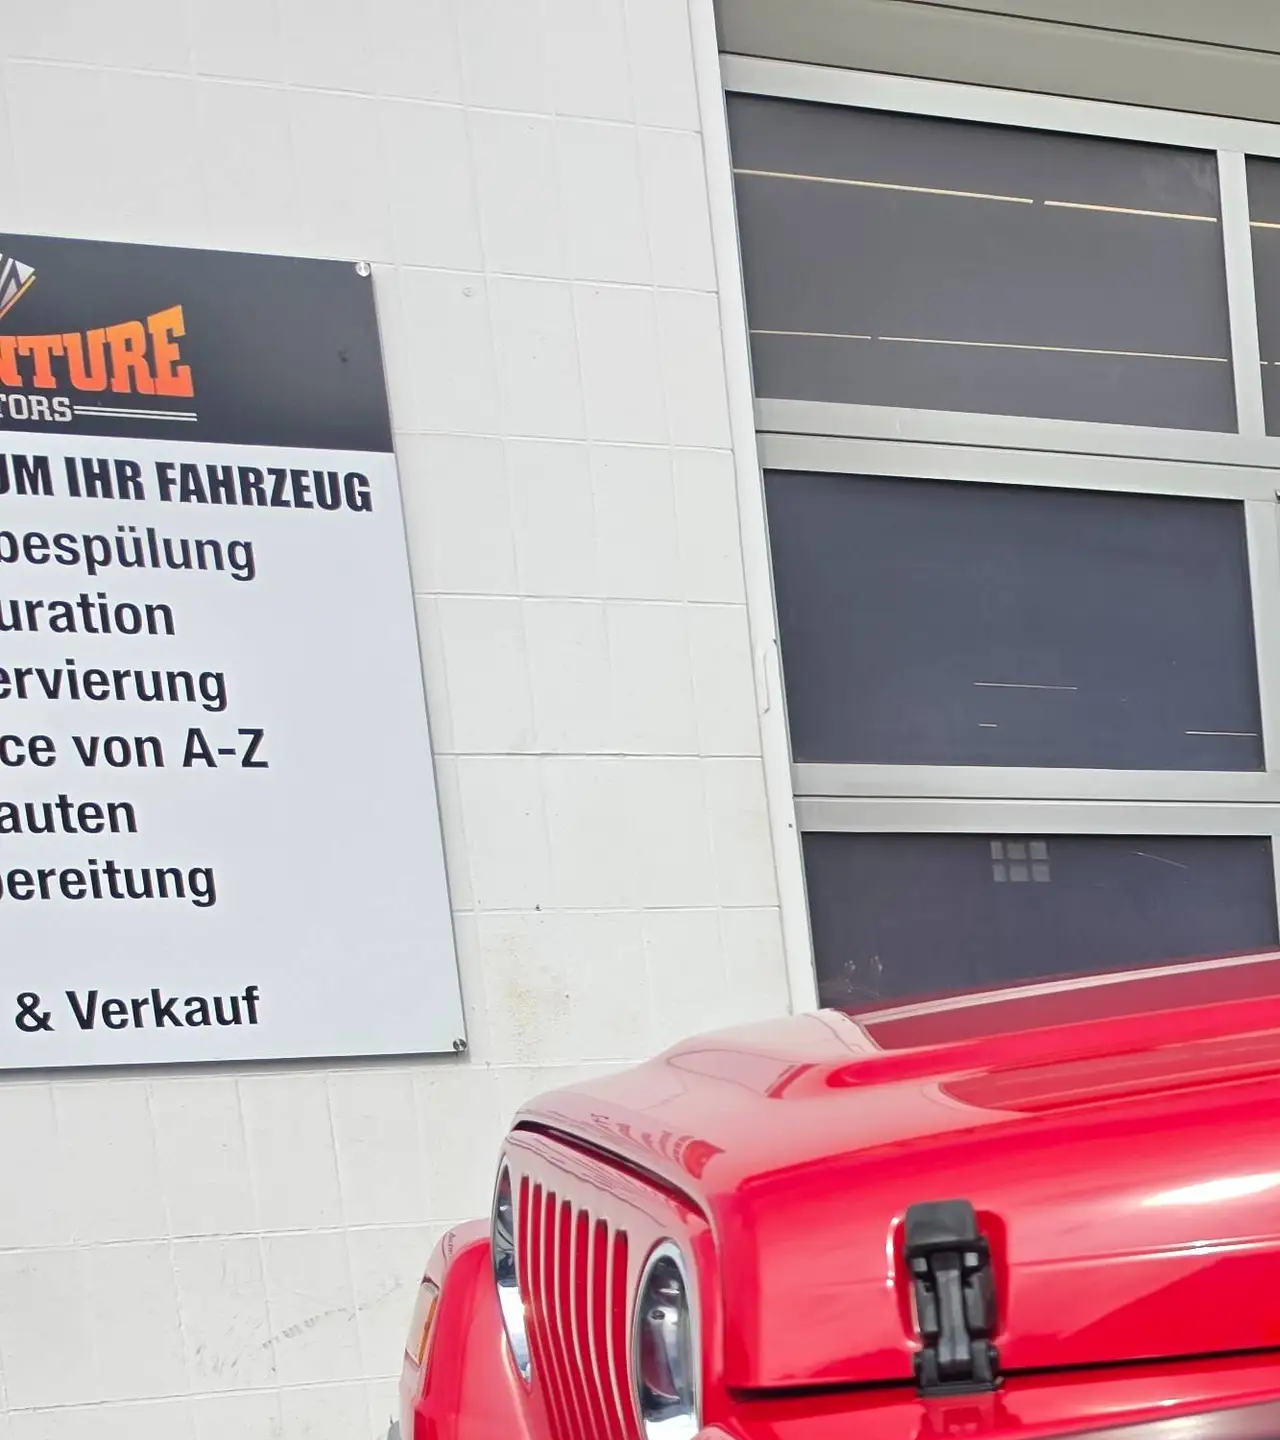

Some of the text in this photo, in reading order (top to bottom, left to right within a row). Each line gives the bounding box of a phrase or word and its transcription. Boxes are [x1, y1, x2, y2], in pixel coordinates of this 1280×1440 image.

[64, 456, 145, 501] IHR
[155, 462, 374, 513] FAHRZEUG
[0, 592, 176, 636] uration
[72, 735, 165, 768] von
[182, 728, 270, 768] A-Z
[0, 859, 217, 907] ereitung
[14, 985, 260, 1032] & Verkauf
